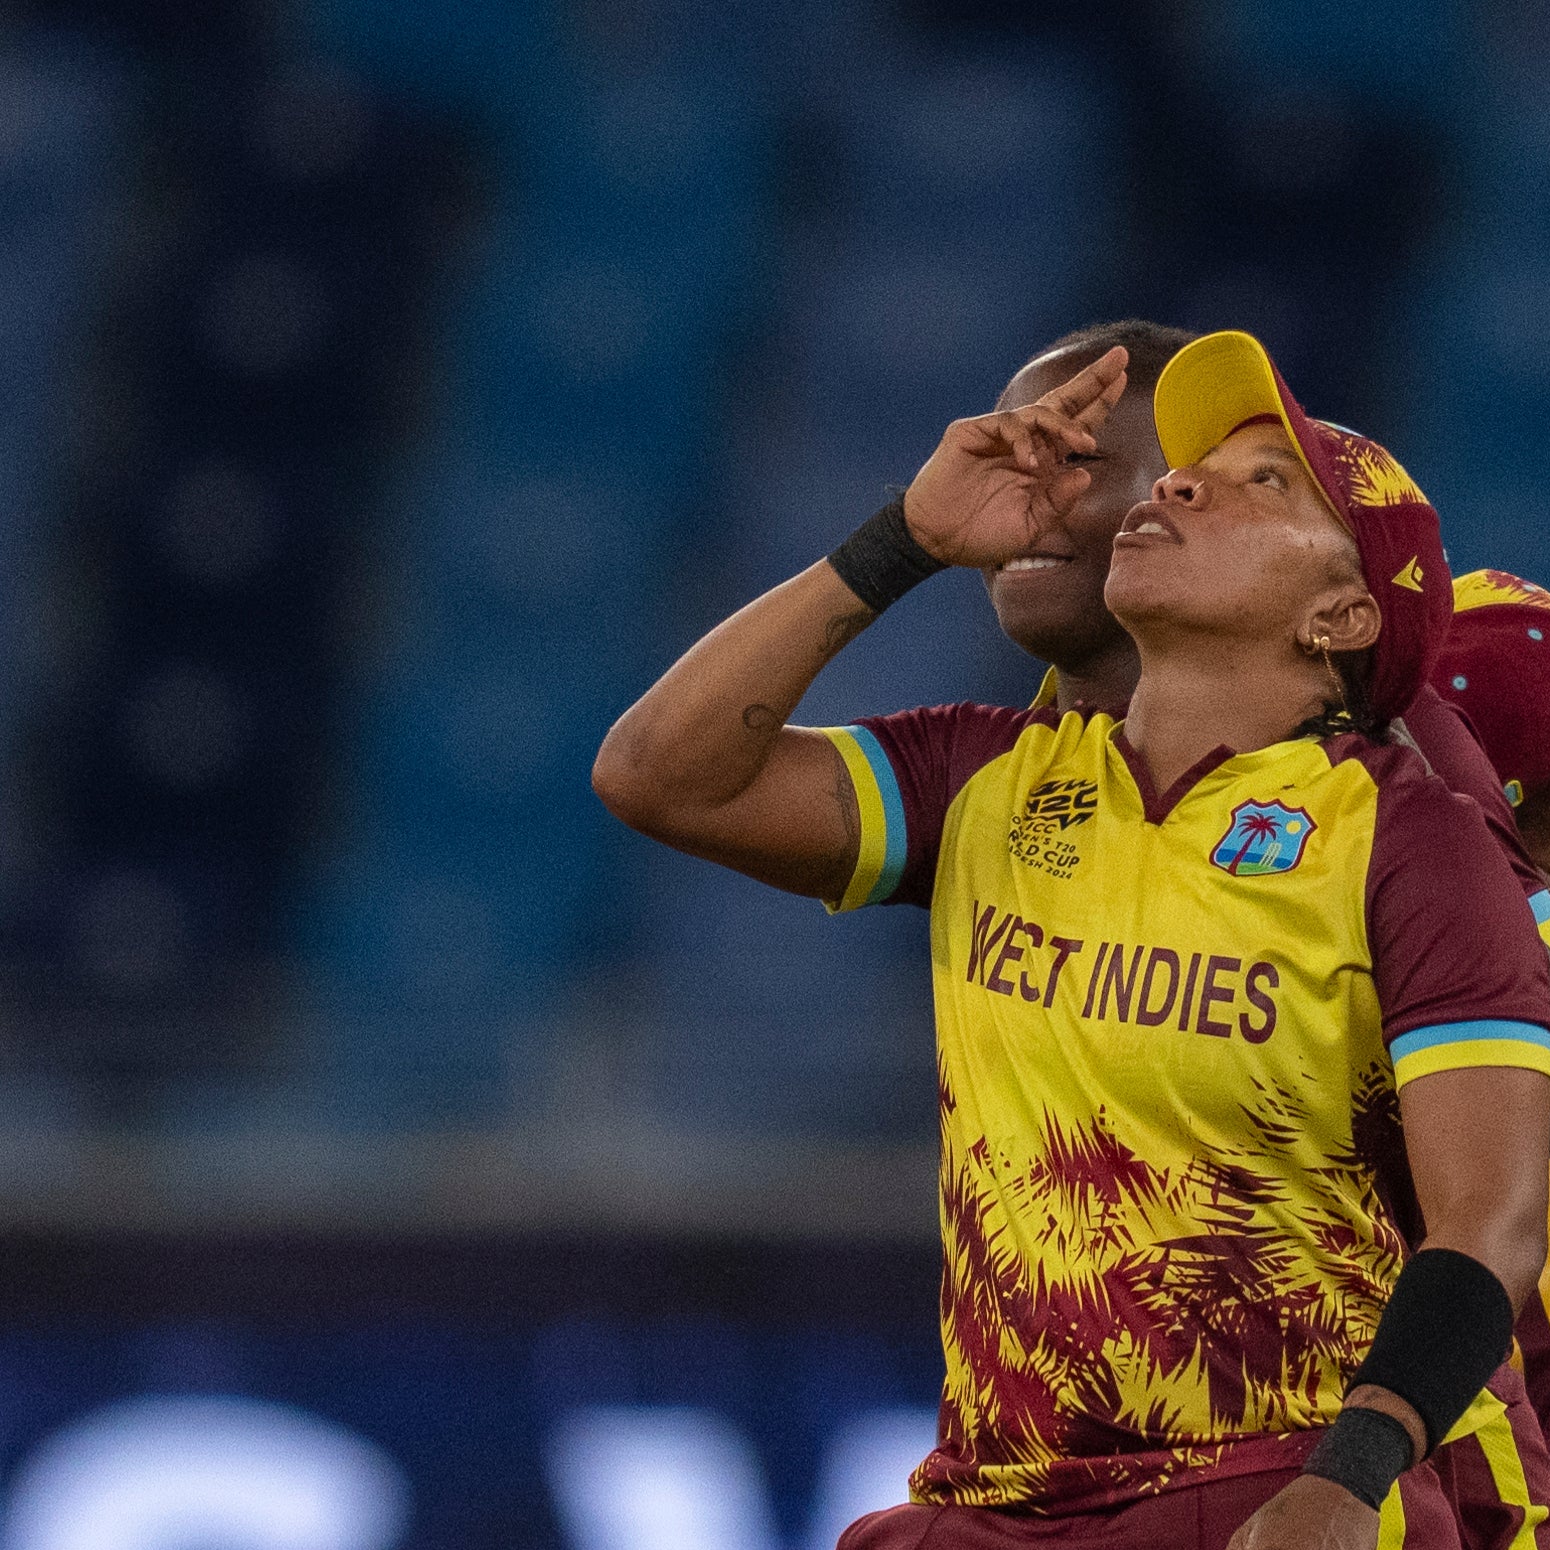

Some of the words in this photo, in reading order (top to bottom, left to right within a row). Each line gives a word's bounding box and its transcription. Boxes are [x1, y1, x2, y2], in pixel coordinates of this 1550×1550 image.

[1043, 850, 1080, 869] CUP
[966, 900, 1084, 1009] WEST
[1081, 941, 1280, 1045] INDIES
